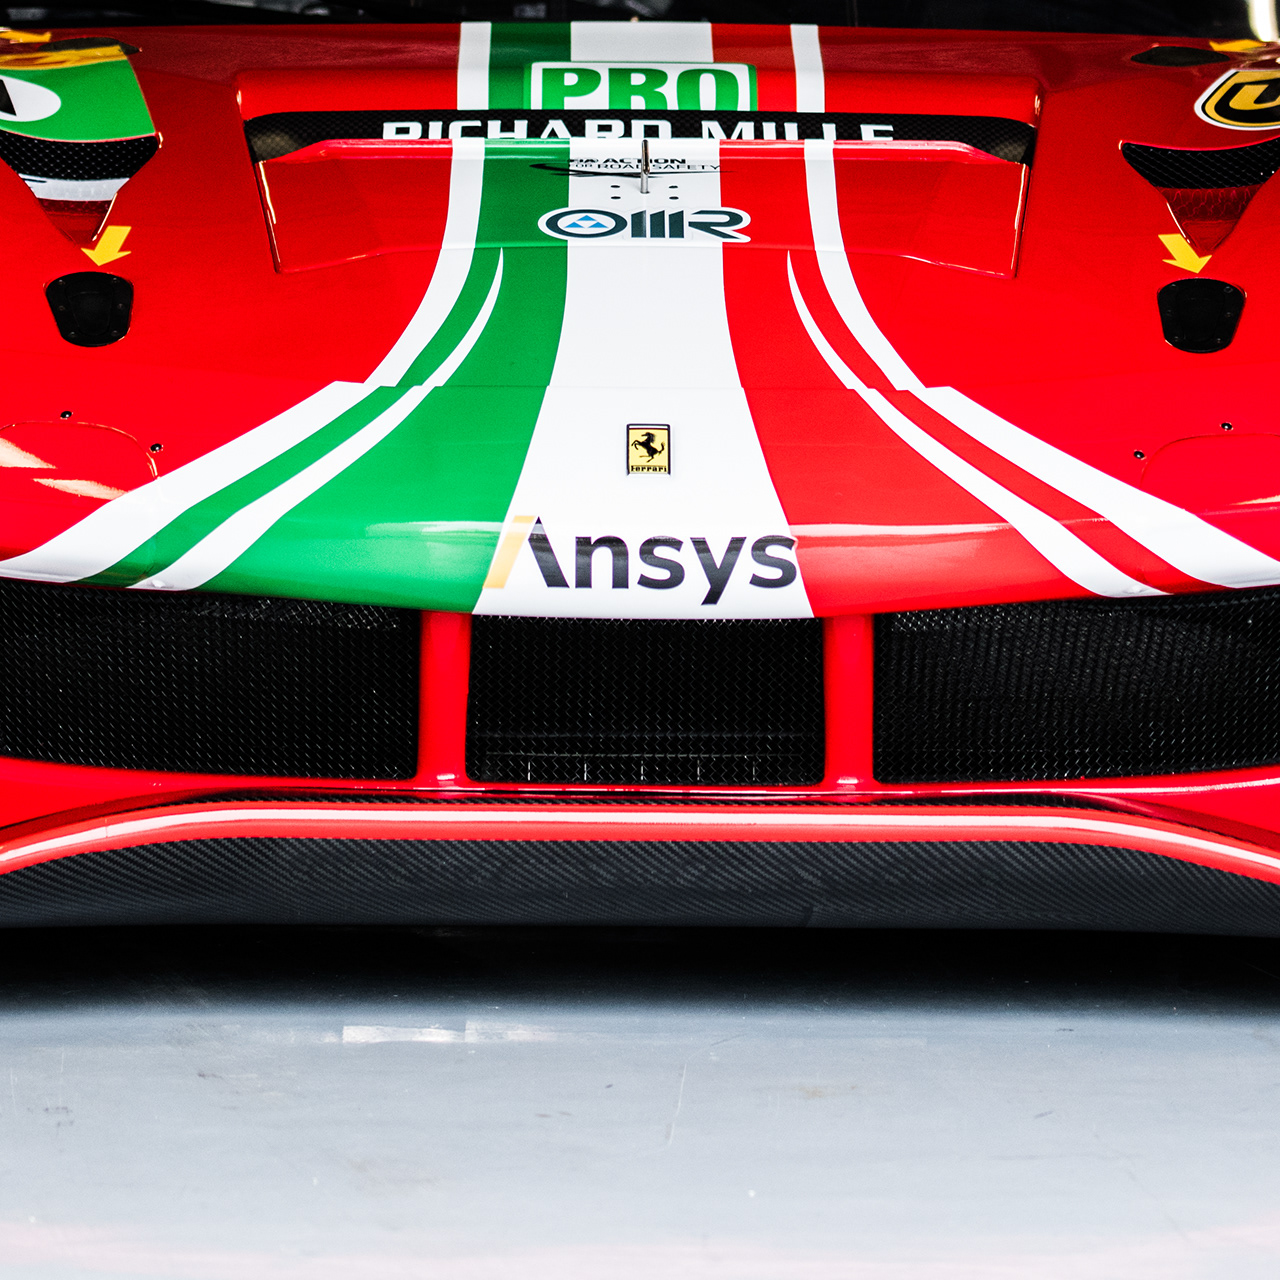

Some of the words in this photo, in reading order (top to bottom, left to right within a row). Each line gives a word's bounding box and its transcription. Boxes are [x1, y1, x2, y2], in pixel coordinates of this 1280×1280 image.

[541, 67, 739, 110] PRO
[382, 119, 672, 139] RICHARD
[630, 464, 667, 473] Ferrari
[482, 515, 798, 606] Ansys
